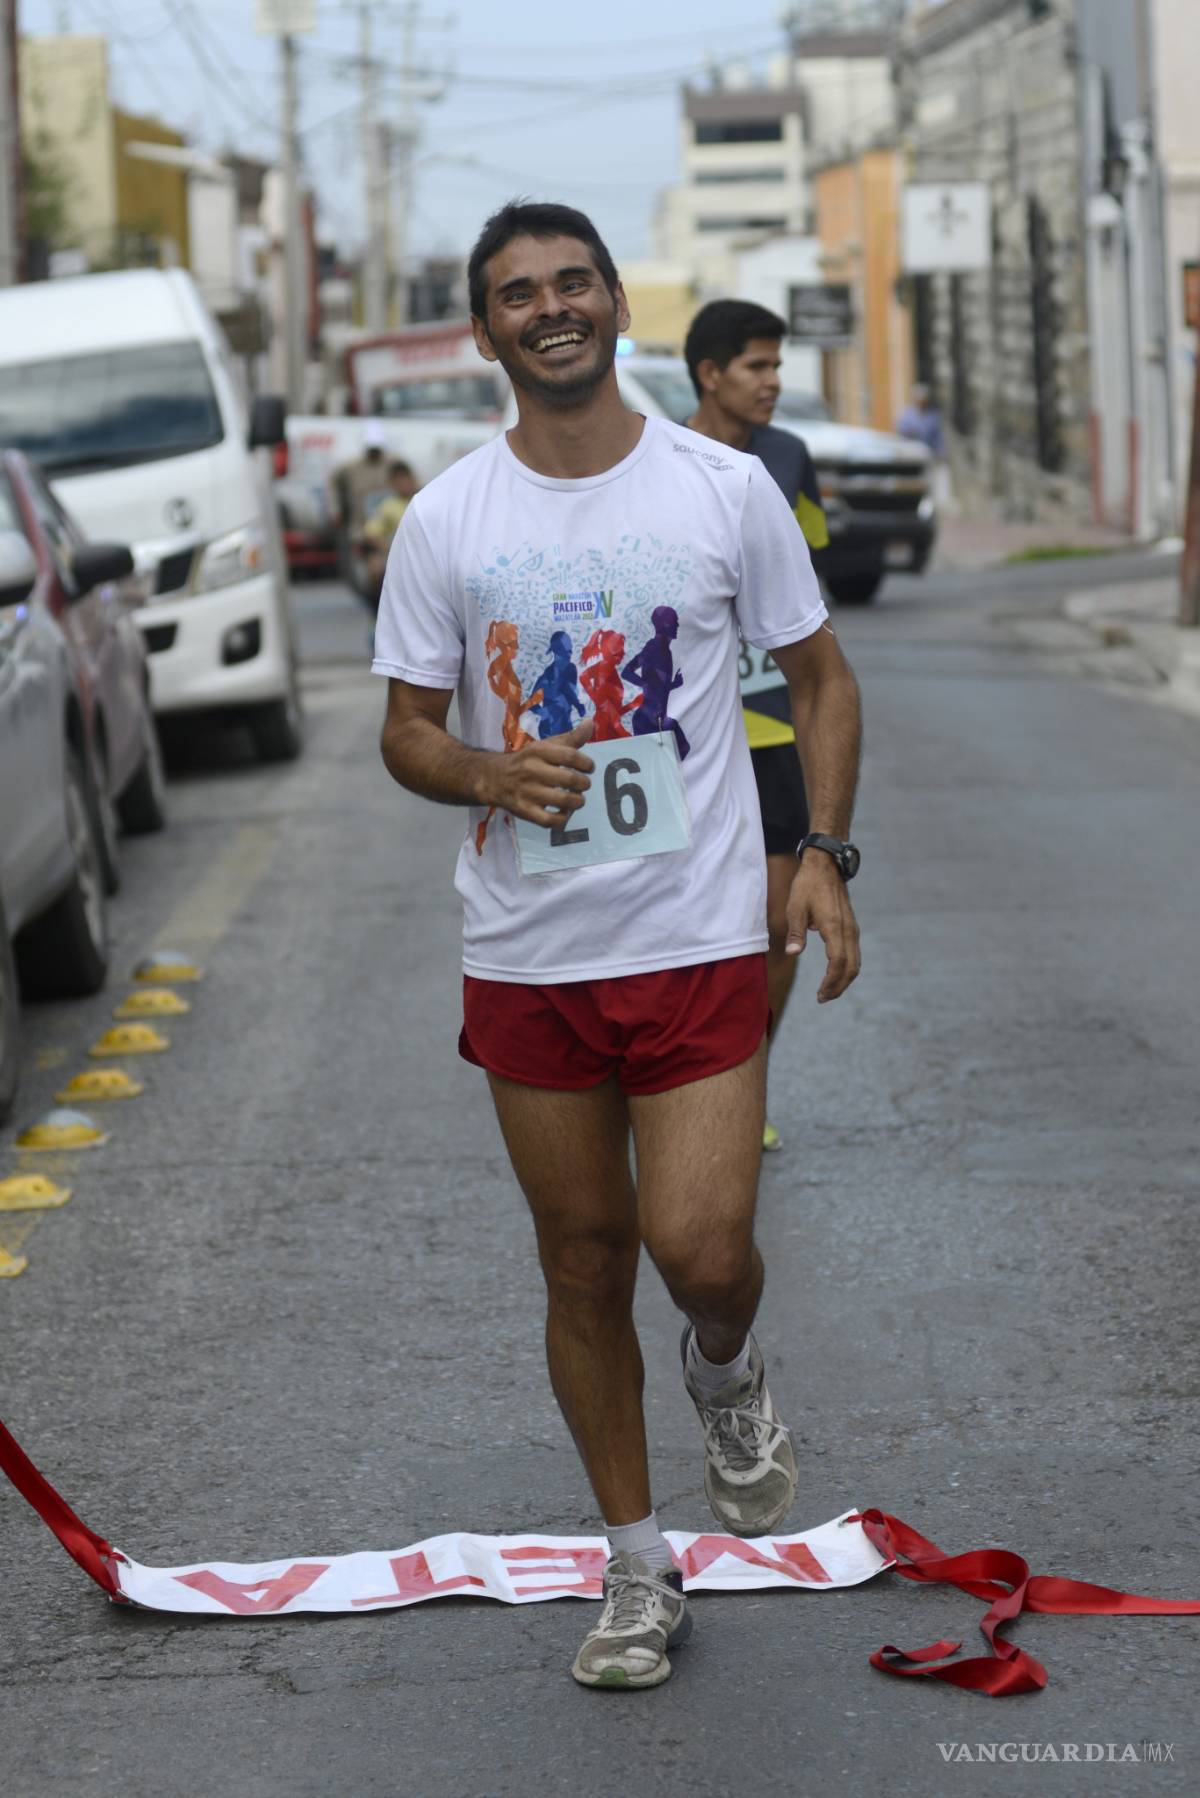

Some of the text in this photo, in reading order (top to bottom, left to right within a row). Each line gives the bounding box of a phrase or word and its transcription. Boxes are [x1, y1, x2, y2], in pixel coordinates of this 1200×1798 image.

[673, 443, 724, 465] saucony
[553, 601, 593, 614] PACIFICO
[592, 589, 613, 619] XV
[173, 1535, 832, 1615] META
